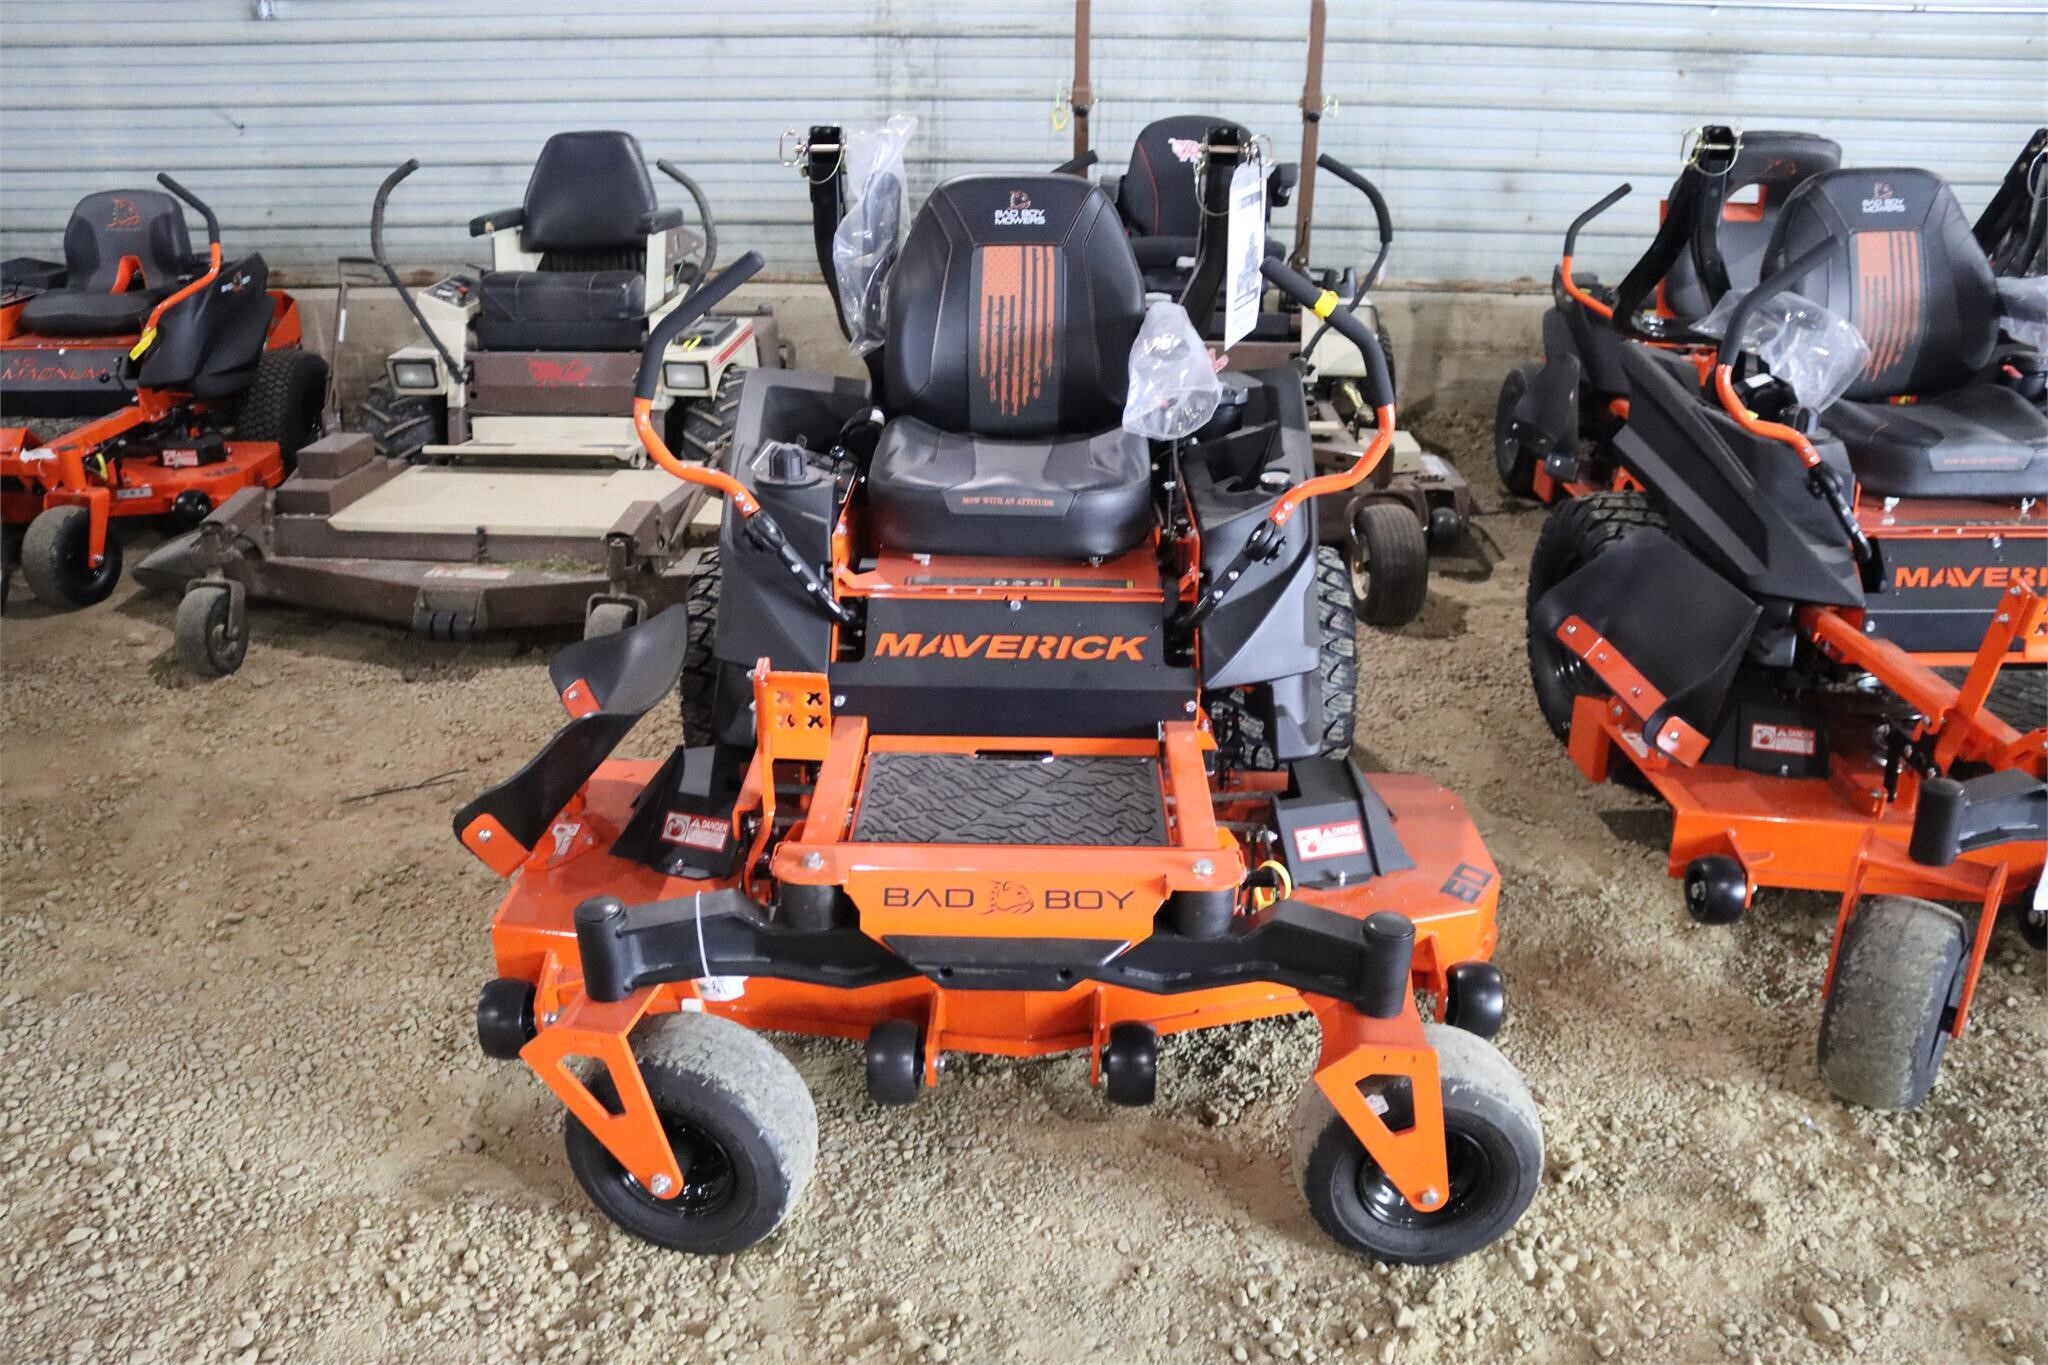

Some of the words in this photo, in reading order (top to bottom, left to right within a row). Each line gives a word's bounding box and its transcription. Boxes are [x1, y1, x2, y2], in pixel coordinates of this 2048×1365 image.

[994, 209, 1019, 217] BAD
[1021, 208, 1046, 217] BOY
[994, 216, 1046, 225] MOWERS
[1, 367, 109, 381] MAGNUM
[982, 496, 1004, 506] WITH
[1017, 498, 1055, 509] ATTITUDE
[874, 632, 1148, 660] MAVERICK
[701, 819, 729, 833] DANGER
[1440, 863, 1493, 904] 60
[883, 887, 975, 908] BAD
[1045, 889, 1135, 909] BOY
